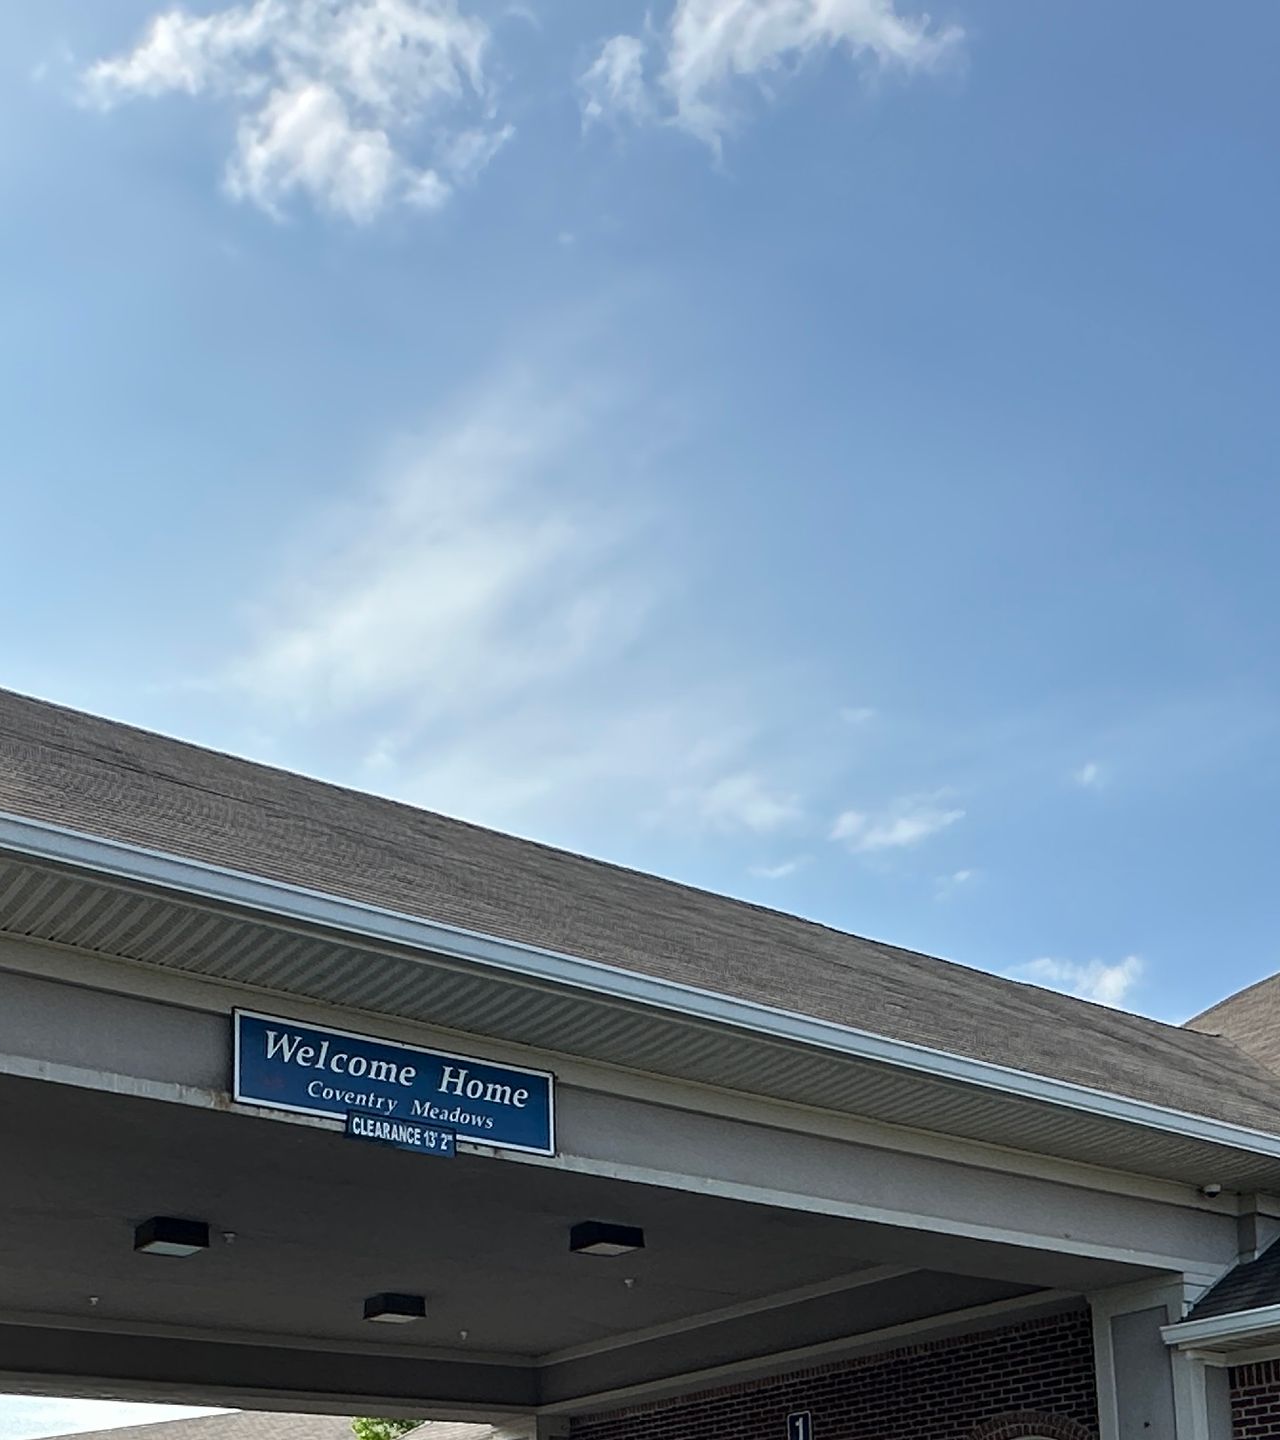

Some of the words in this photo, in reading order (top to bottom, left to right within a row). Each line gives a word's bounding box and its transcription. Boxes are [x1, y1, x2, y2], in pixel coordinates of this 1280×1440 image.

[265, 1030, 417, 1086] Welcome
[437, 1065, 529, 1108] Home
[307, 1080, 398, 1115] Coventry
[410, 1099, 494, 1129] Meadows
[352, 1116, 421, 1145] CLEARANCE
[795, 1417, 804, 1440] 1
